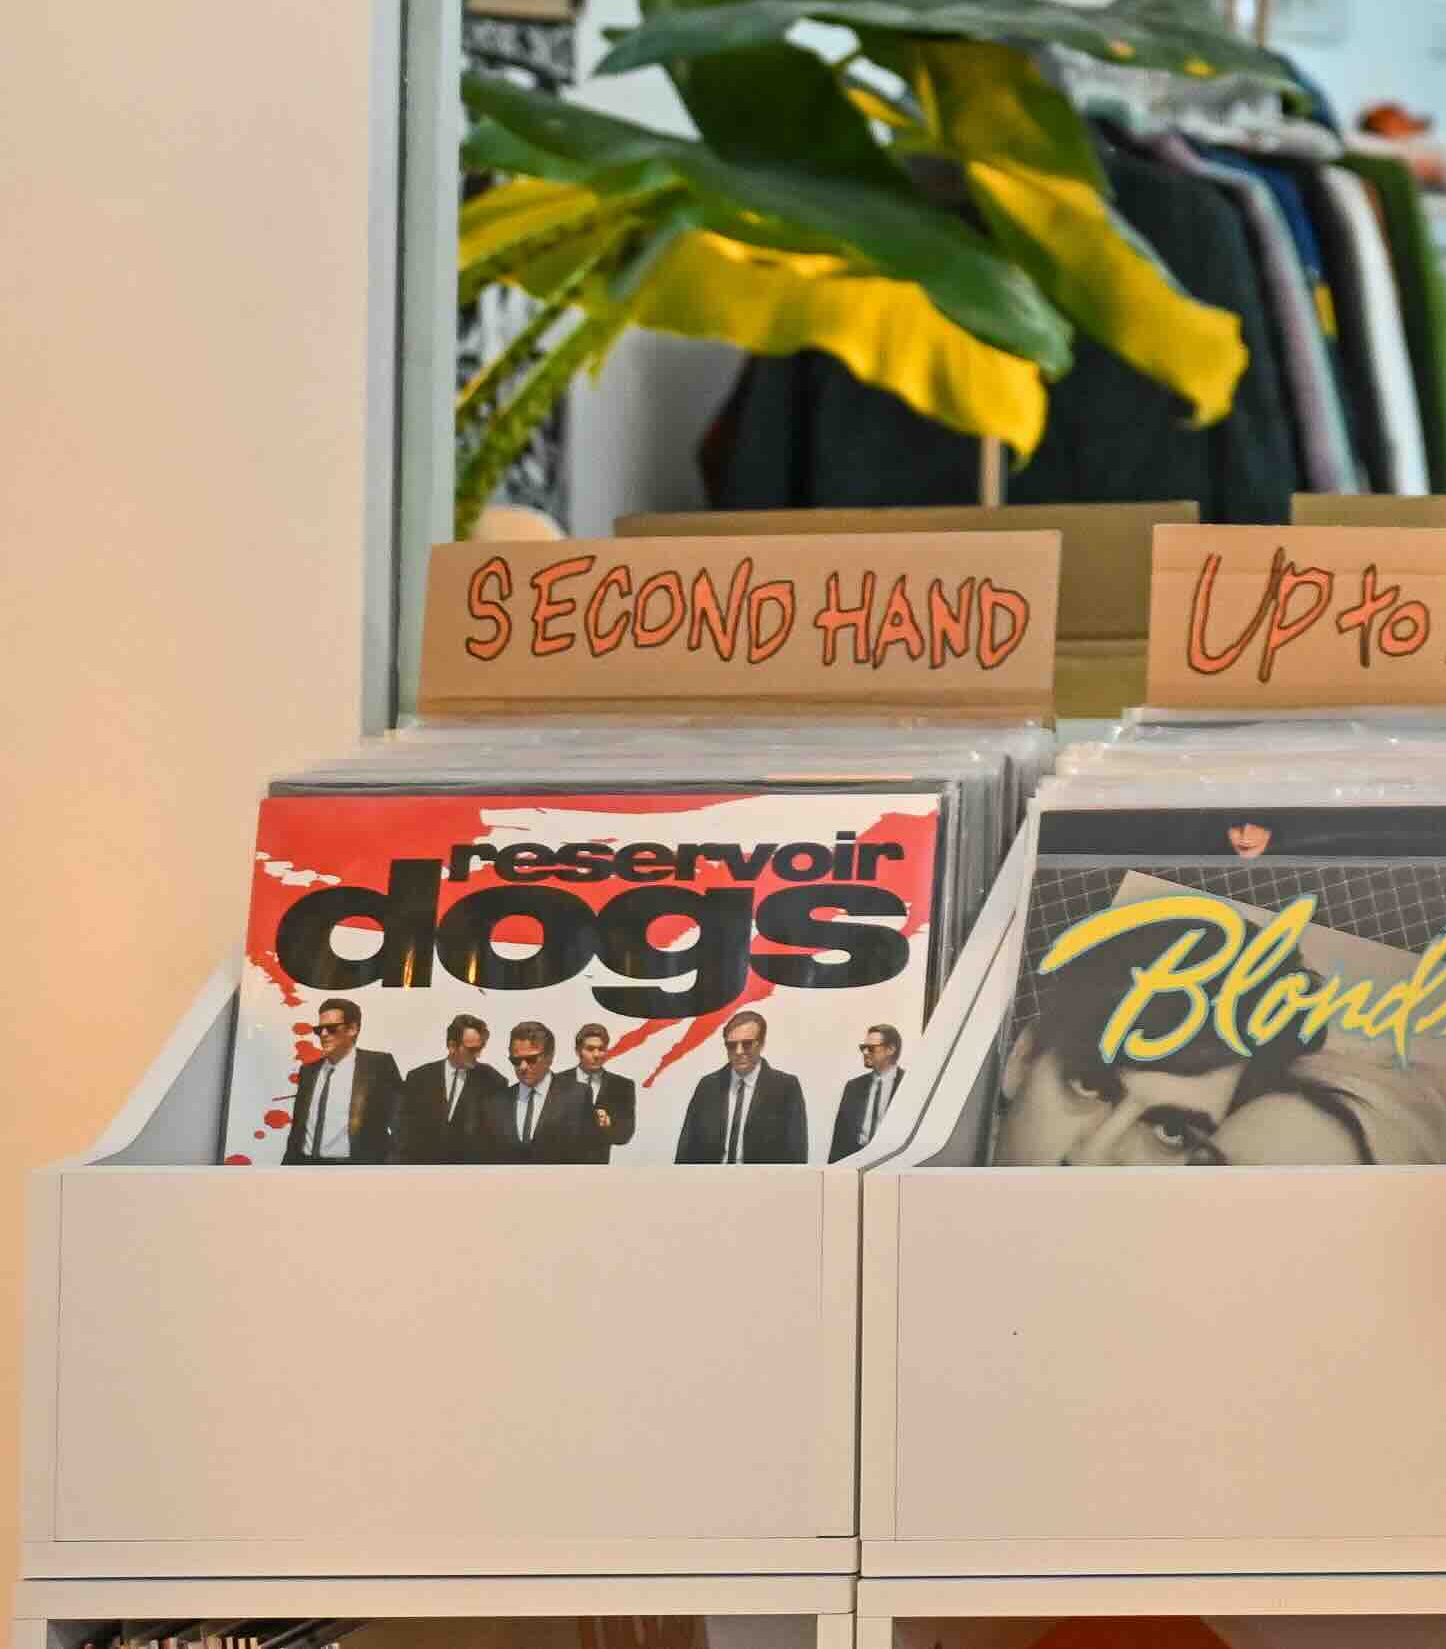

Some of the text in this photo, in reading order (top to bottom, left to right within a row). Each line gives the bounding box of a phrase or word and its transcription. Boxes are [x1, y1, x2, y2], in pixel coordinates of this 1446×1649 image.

[465, 555, 1031, 670] SECOND HAND
[1336, 563, 1431, 669] to
[448, 830, 905, 884] reservoir
[275, 858, 911, 1020] dogs
